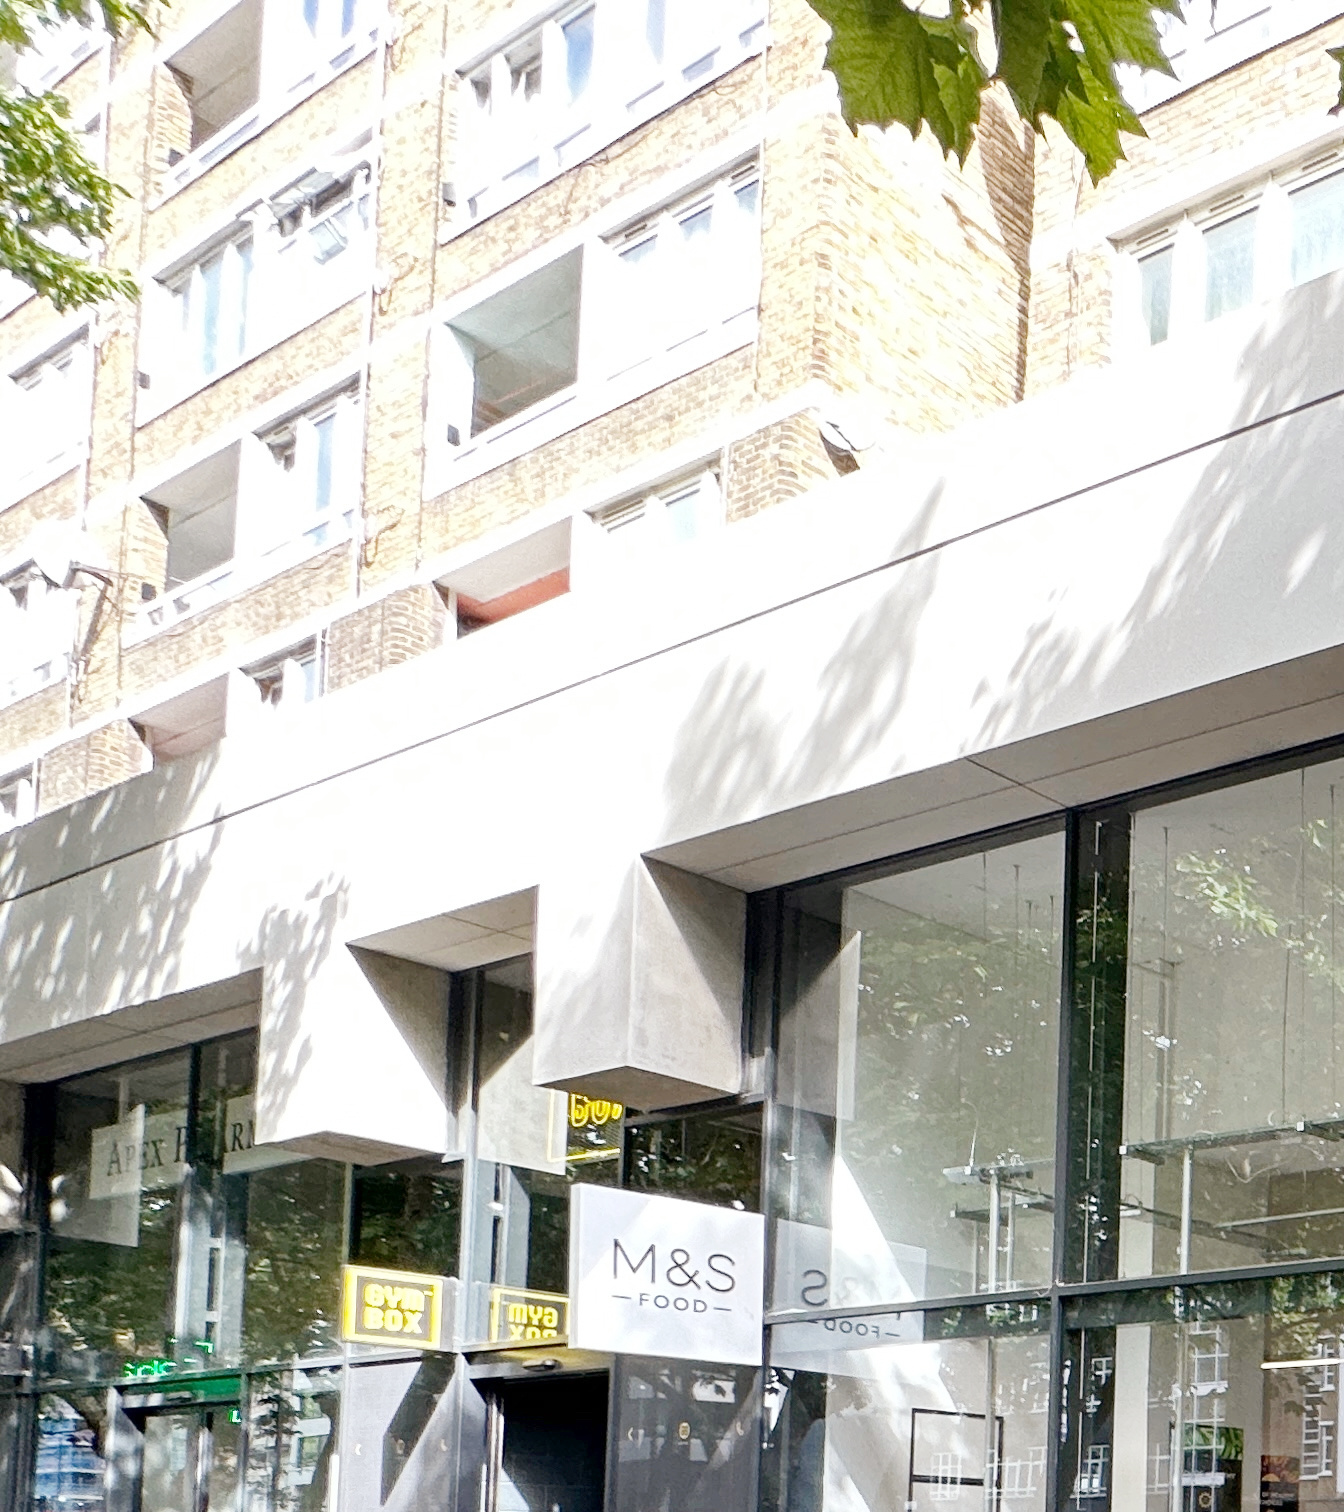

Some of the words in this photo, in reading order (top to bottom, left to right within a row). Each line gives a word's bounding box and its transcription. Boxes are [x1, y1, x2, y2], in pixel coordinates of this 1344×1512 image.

[613, 1238, 736, 1293] M&S
[363, 1283, 426, 1312] GYM
[639, 1292, 708, 1313] FOOD
[363, 1306, 423, 1334] BOX
